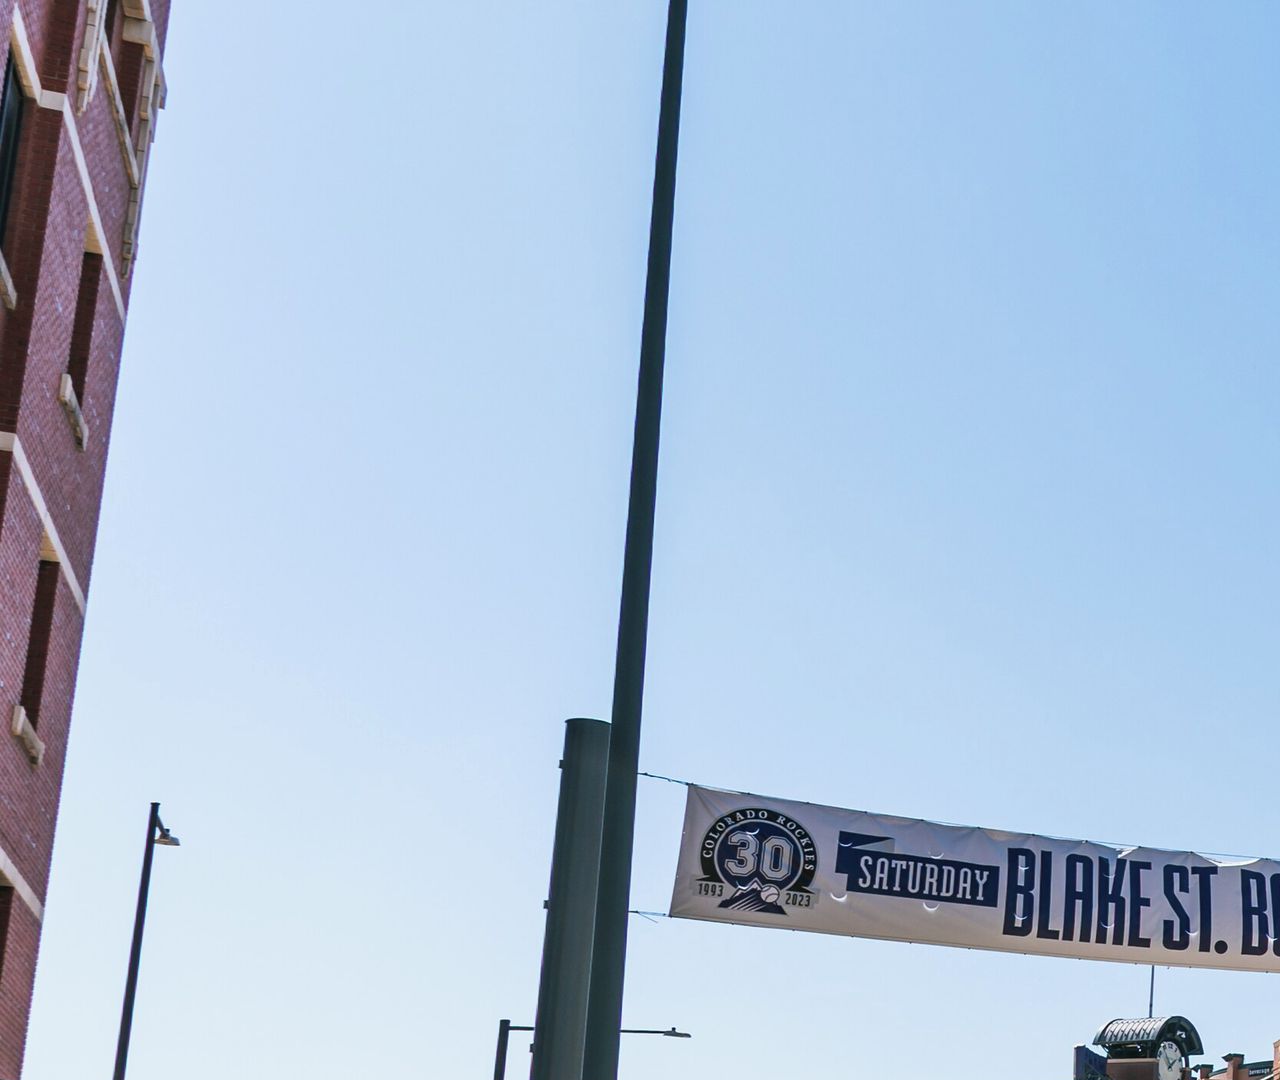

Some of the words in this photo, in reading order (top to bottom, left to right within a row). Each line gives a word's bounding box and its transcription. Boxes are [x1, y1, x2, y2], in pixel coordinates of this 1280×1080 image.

[702, 809, 769, 858] COLORADO
[776, 814, 815, 871] ROCKIES
[724, 830, 794, 882] 30
[698, 883, 724, 898] 1993
[785, 892, 811, 907] 2023
[858, 855, 989, 901] SATURDAY
[1002, 847, 1152, 949] BLAKE
[1162, 864, 1228, 955] ST.
